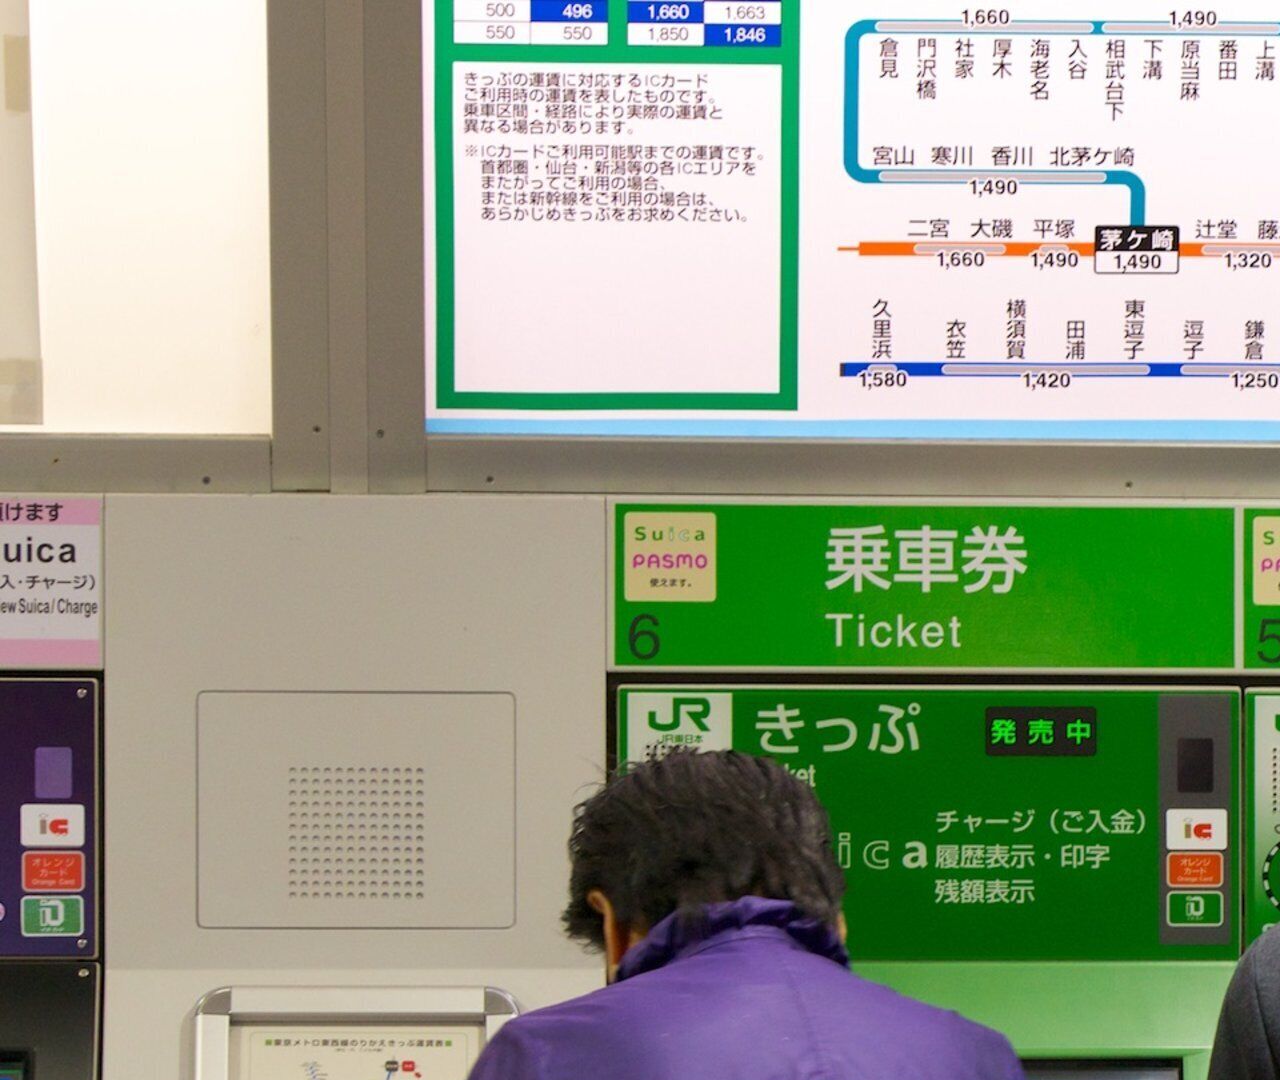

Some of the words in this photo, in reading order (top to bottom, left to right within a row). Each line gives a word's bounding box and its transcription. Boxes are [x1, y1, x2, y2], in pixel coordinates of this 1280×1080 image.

[486, 5, 514, 17] 500
[562, 6, 592, 18] 496
[648, 6, 689, 21] 1,660
[724, 7, 764, 20] 1,663
[962, 10, 1009, 26] 1,660
[486, 26, 514, 39] 550
[563, 27, 592, 40] 550
[648, 28, 689, 42] 1,850
[724, 28, 765, 42] 1,846
[880, 38, 898, 78] 倉見
[956, 39, 973, 78] 社家
[1143, 40, 1162, 80] 下溝
[1219, 40, 1237, 80] 番田
[1031, 39, 1049, 99] 海老名
[464, 72, 709, 88] きっぷの運賃に対応するICカード
[464, 88, 717, 104] ご利用時の運賃を表したものです。
[462, 104, 723, 120] 乗車区間・経路により実際の運賃と
[464, 119, 636, 136] 異なる場合があります。
[465, 144, 764, 161] ※ICカードご利用可能駅までの運賃です。
[873, 146, 914, 165] 宮山
[992, 146, 1032, 166] 香川
[481, 161, 756, 176] 首都圏・仙台・新潟等の各ICエリアを
[481, 176, 666, 191] またがってご利用の場合、
[481, 191, 715, 207] または新幹線をご利用の場合は、
[481, 207, 746, 223] あらかじめきっぷをお求めください。
[909, 219, 949, 237] 二宮
[1034, 220, 1074, 238] 平塚
[1100, 229, 1175, 250] 茅ケ崎
[1032, 253, 1078, 269] 1,490
[1225, 253, 1271, 270] 1,320
[872, 299, 891, 358] 久里浜
[1007, 300, 1025, 359] 横須賀
[1125, 300, 1144, 359] 東逗子
[1245, 321, 1264, 359] 鎌倉
[1024, 373, 1070, 390] 1,420
[634, 526, 706, 542] Suica
[4, 536, 76, 563] uica
[633, 554, 708, 569] PASMO
[825, 525, 1027, 593] 乗車券
[650, 578, 692, 588] 使えます。
[19, 598, 50, 613] Suica
[57, 598, 97, 618] Charge
[628, 613, 660, 660] 6
[825, 612, 961, 648] Ticket
[648, 697, 711, 732] JR
[755, 701, 920, 754] きっぷ
[990, 719, 1091, 745] 発売中
[935, 809, 1148, 835] チャージ（ご入金）
[935, 844, 1109, 869] 履歴表示・印字
[935, 879, 1035, 904] 残額表示
